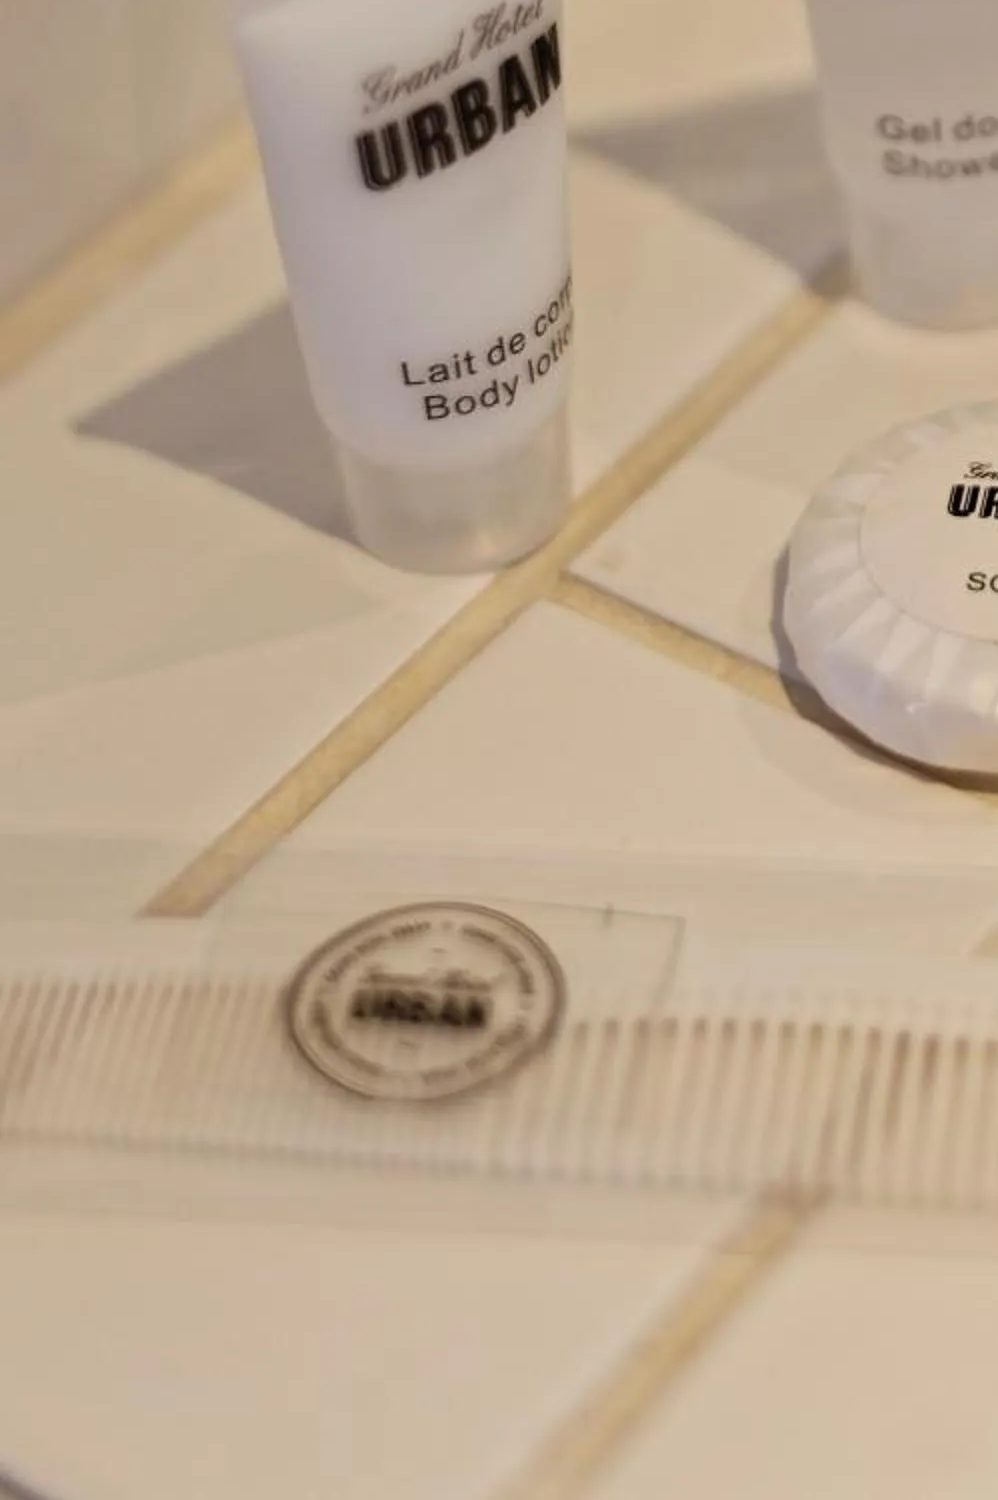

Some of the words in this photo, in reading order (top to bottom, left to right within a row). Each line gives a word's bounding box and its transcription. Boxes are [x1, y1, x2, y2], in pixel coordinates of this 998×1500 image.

[361, 27, 466, 115] Grand
[355, 21, 562, 192] URBAN
[876, 113, 942, 143] Gel
[401, 351, 477, 386] Lait
[487, 336, 526, 366] de
[424, 375, 519, 420] Body
